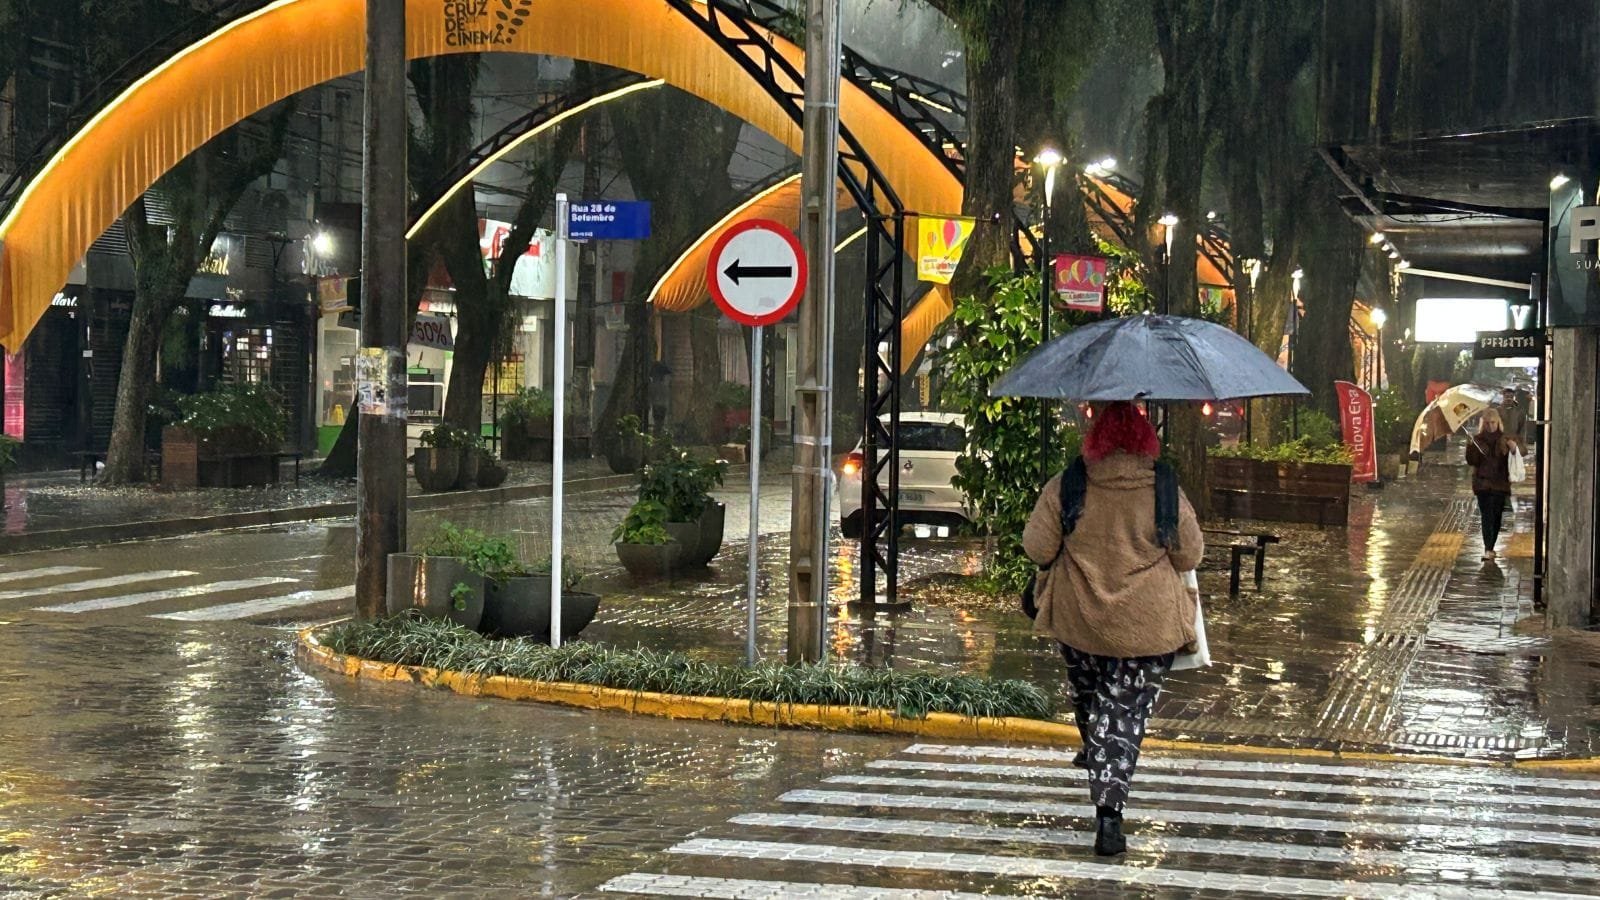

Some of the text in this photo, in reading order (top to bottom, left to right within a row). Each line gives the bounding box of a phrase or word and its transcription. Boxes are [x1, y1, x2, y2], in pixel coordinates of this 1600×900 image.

[444, 0, 488, 21] CRUZ
[445, 17, 466, 33] DE
[446, 29, 506, 46] CINEMA
[571, 203, 616, 213] Rua 28 de
[571, 213, 615, 222] Setembro
[415, 320, 448, 346] 50%
